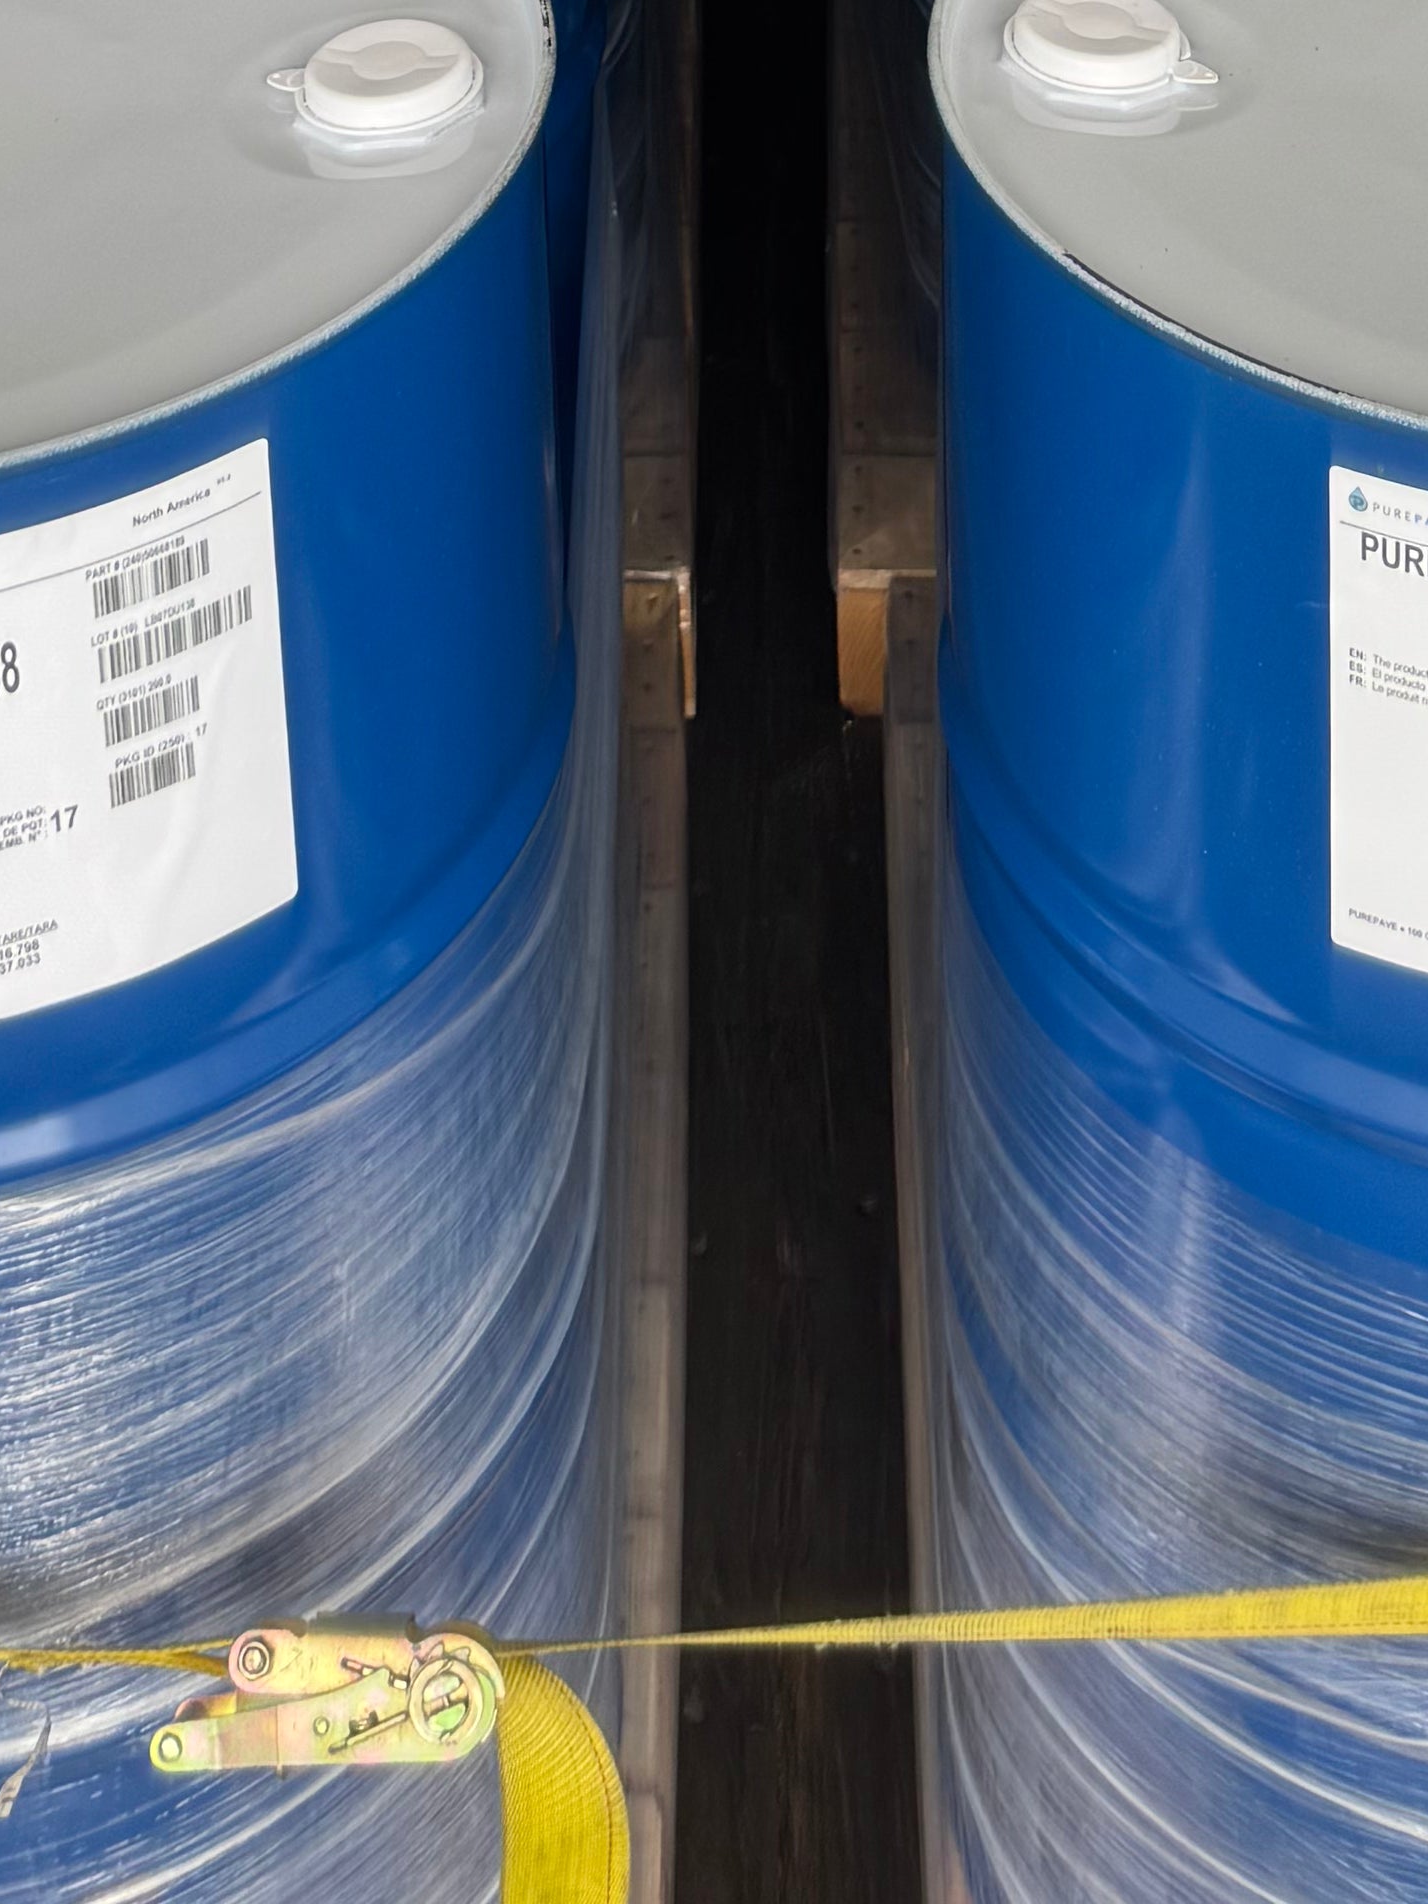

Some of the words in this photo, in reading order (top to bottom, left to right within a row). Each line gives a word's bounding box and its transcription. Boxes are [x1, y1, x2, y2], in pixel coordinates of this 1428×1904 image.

[133, 508, 164, 528] North
[167, 488, 211, 513] America
[85, 563, 112, 581] PART
[90, 633, 110, 648] LOT
[1372, 654, 1391, 669] The
[96, 694, 117, 711] QTY
[115, 751, 141, 769] PKG
[143, 745, 155, 758] ID
[50, 804, 78, 833] 17
